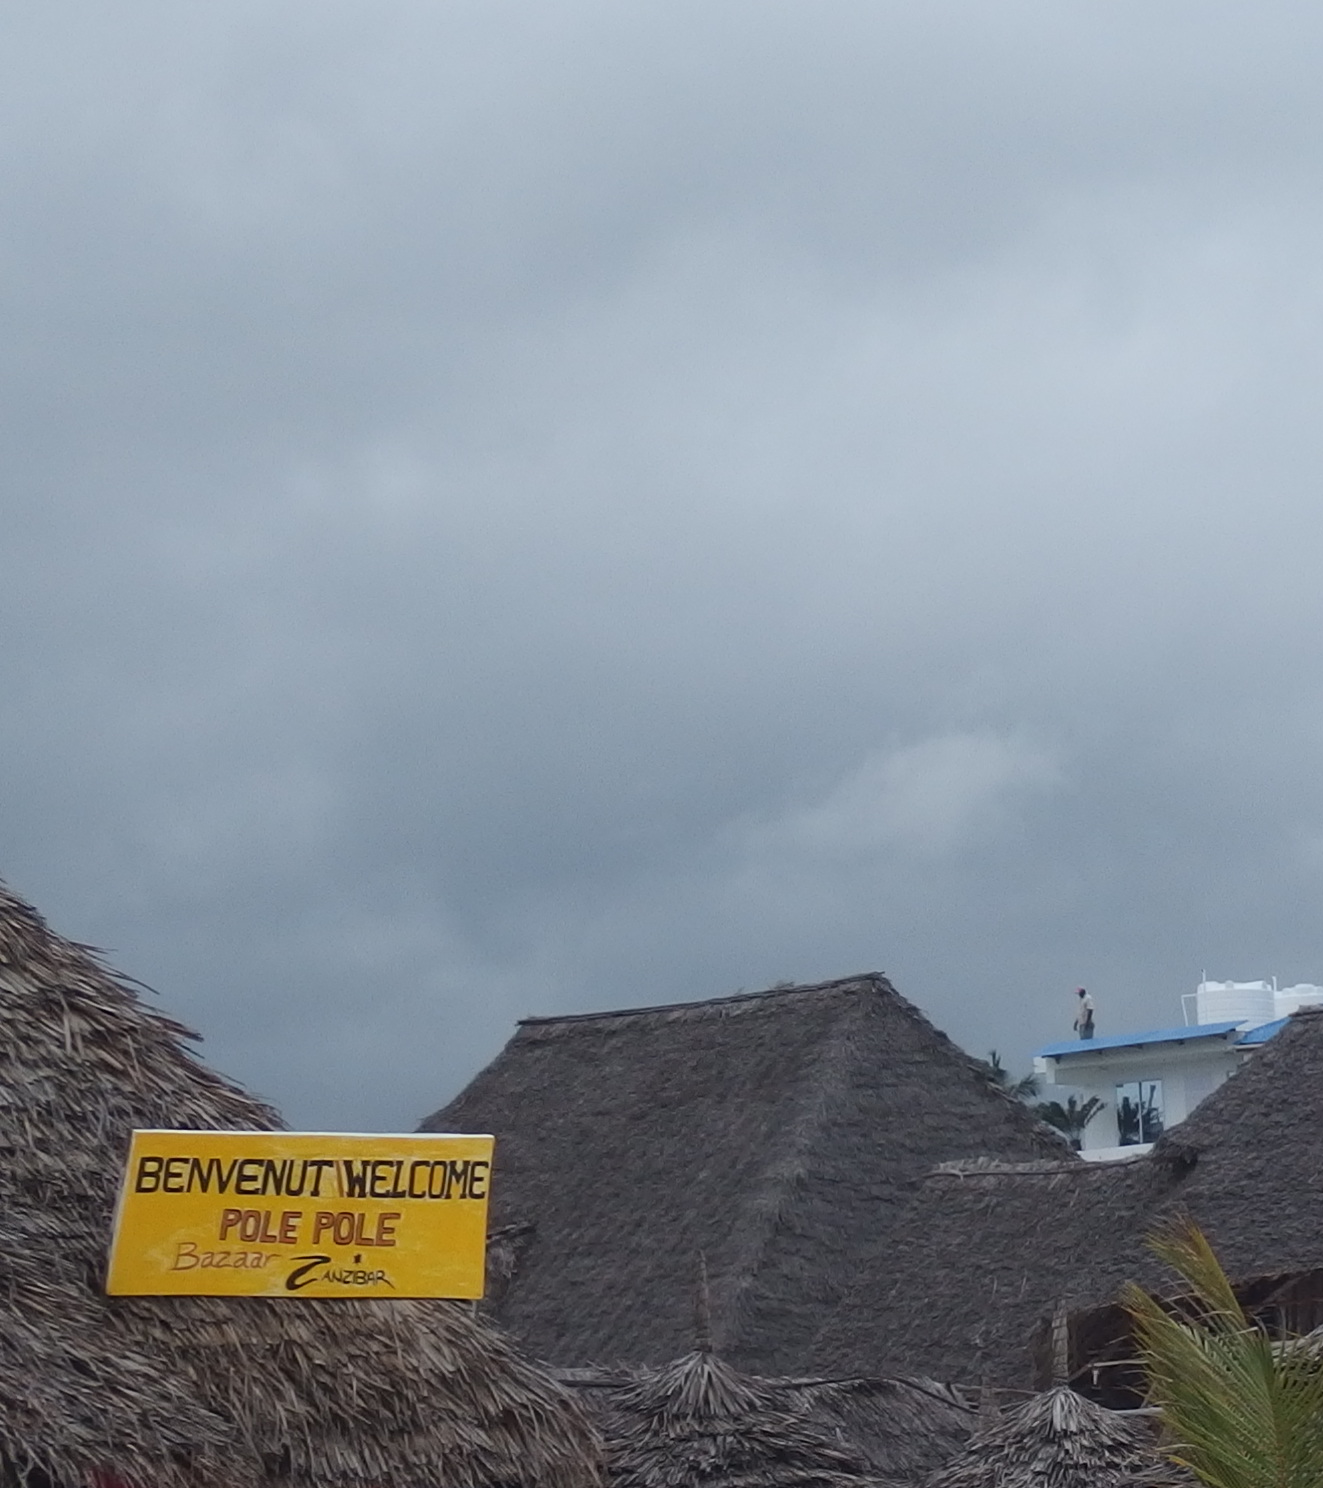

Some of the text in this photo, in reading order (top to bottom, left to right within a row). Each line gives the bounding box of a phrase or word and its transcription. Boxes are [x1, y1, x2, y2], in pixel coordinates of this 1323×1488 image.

[219, 1208, 401, 1246] POLE POLE
[170, 1242, 279, 1270] Bazaar
